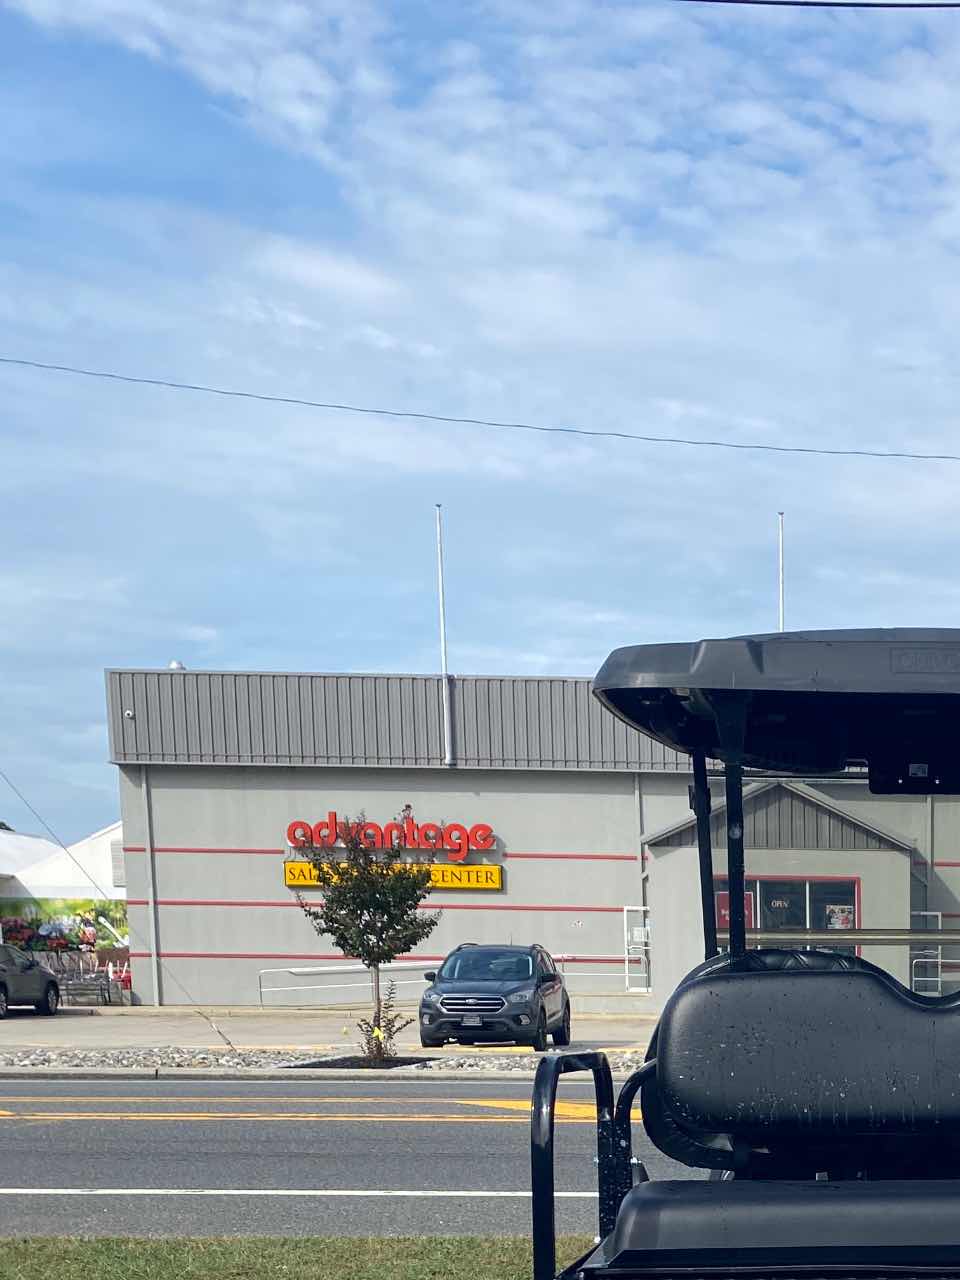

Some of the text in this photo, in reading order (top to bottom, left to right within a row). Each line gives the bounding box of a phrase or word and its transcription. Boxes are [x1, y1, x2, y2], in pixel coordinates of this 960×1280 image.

[287, 811, 496, 861] advantage
[431, 869, 496, 884] CENTER
[771, 900, 789, 908] OPEN
